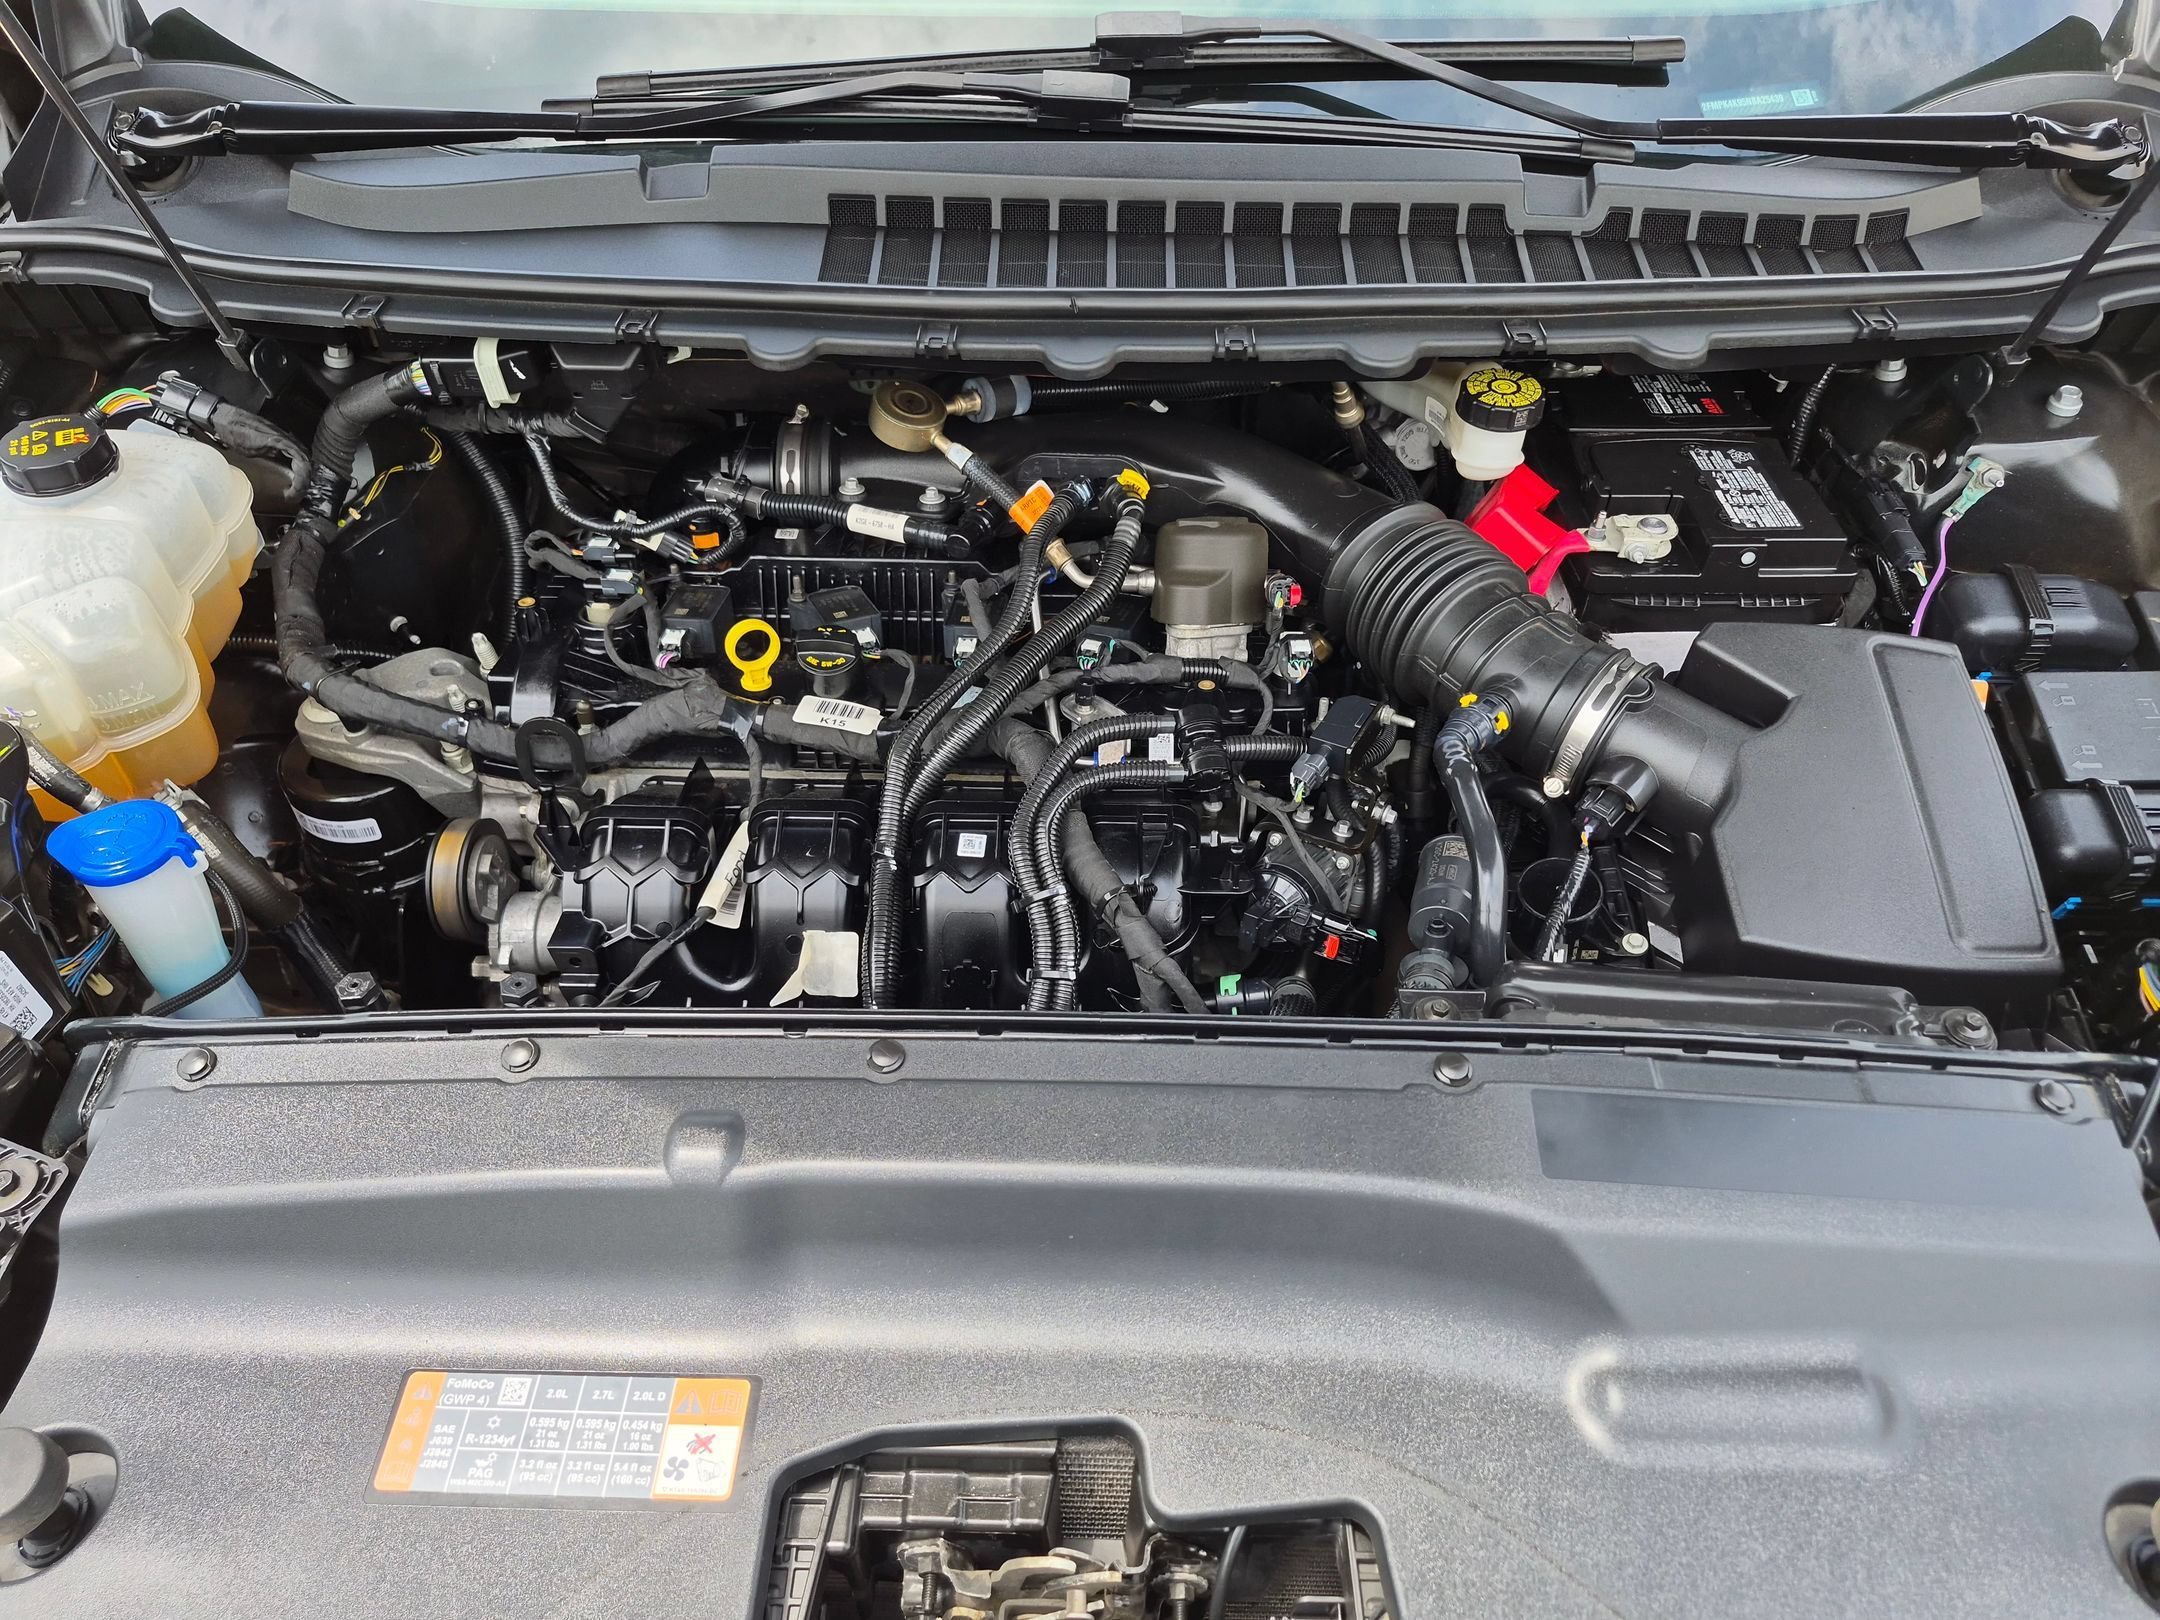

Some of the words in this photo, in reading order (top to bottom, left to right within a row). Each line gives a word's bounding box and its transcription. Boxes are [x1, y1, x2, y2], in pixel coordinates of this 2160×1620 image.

[819, 716, 847, 727] K15
[446, 1378, 495, 1390] FoMoCo
[545, 1388, 569, 1399] 2.0L
[592, 1390, 616, 1400] 2.7L
[632, 1391, 656, 1401] 2.0L
[657, 1391, 667, 1401] D
[439, 1393, 476, 1406] (GWP
[476, 1394, 491, 1408] 4)
[433, 1424, 457, 1434] SAE
[529, 1417, 557, 1428] 0.595
[557, 1418, 571, 1431] kg
[575, 1418, 603, 1429] 0.595
[603, 1419, 617, 1432] kg
[622, 1419, 649, 1430] 0.454
[649, 1420, 664, 1433] kg
[547, 1430, 559, 1438] oz
[594, 1432, 606, 1440] oz
[641, 1433, 652, 1441] oz
[465, 1432, 517, 1448] R-1234yf
[547, 1439, 561, 1449] lbs
[593, 1441, 608, 1451] lbs
[640, 1442, 655, 1452] lbs
[519, 1458, 536, 1470] 3.2
[545, 1460, 559, 1470] oz
[567, 1460, 583, 1471] 3.2
[593, 1462, 606, 1472] oz
[613, 1462, 629, 1473] 5.4
[639, 1464, 653, 1473] oz
[466, 1467, 494, 1479] PAG
